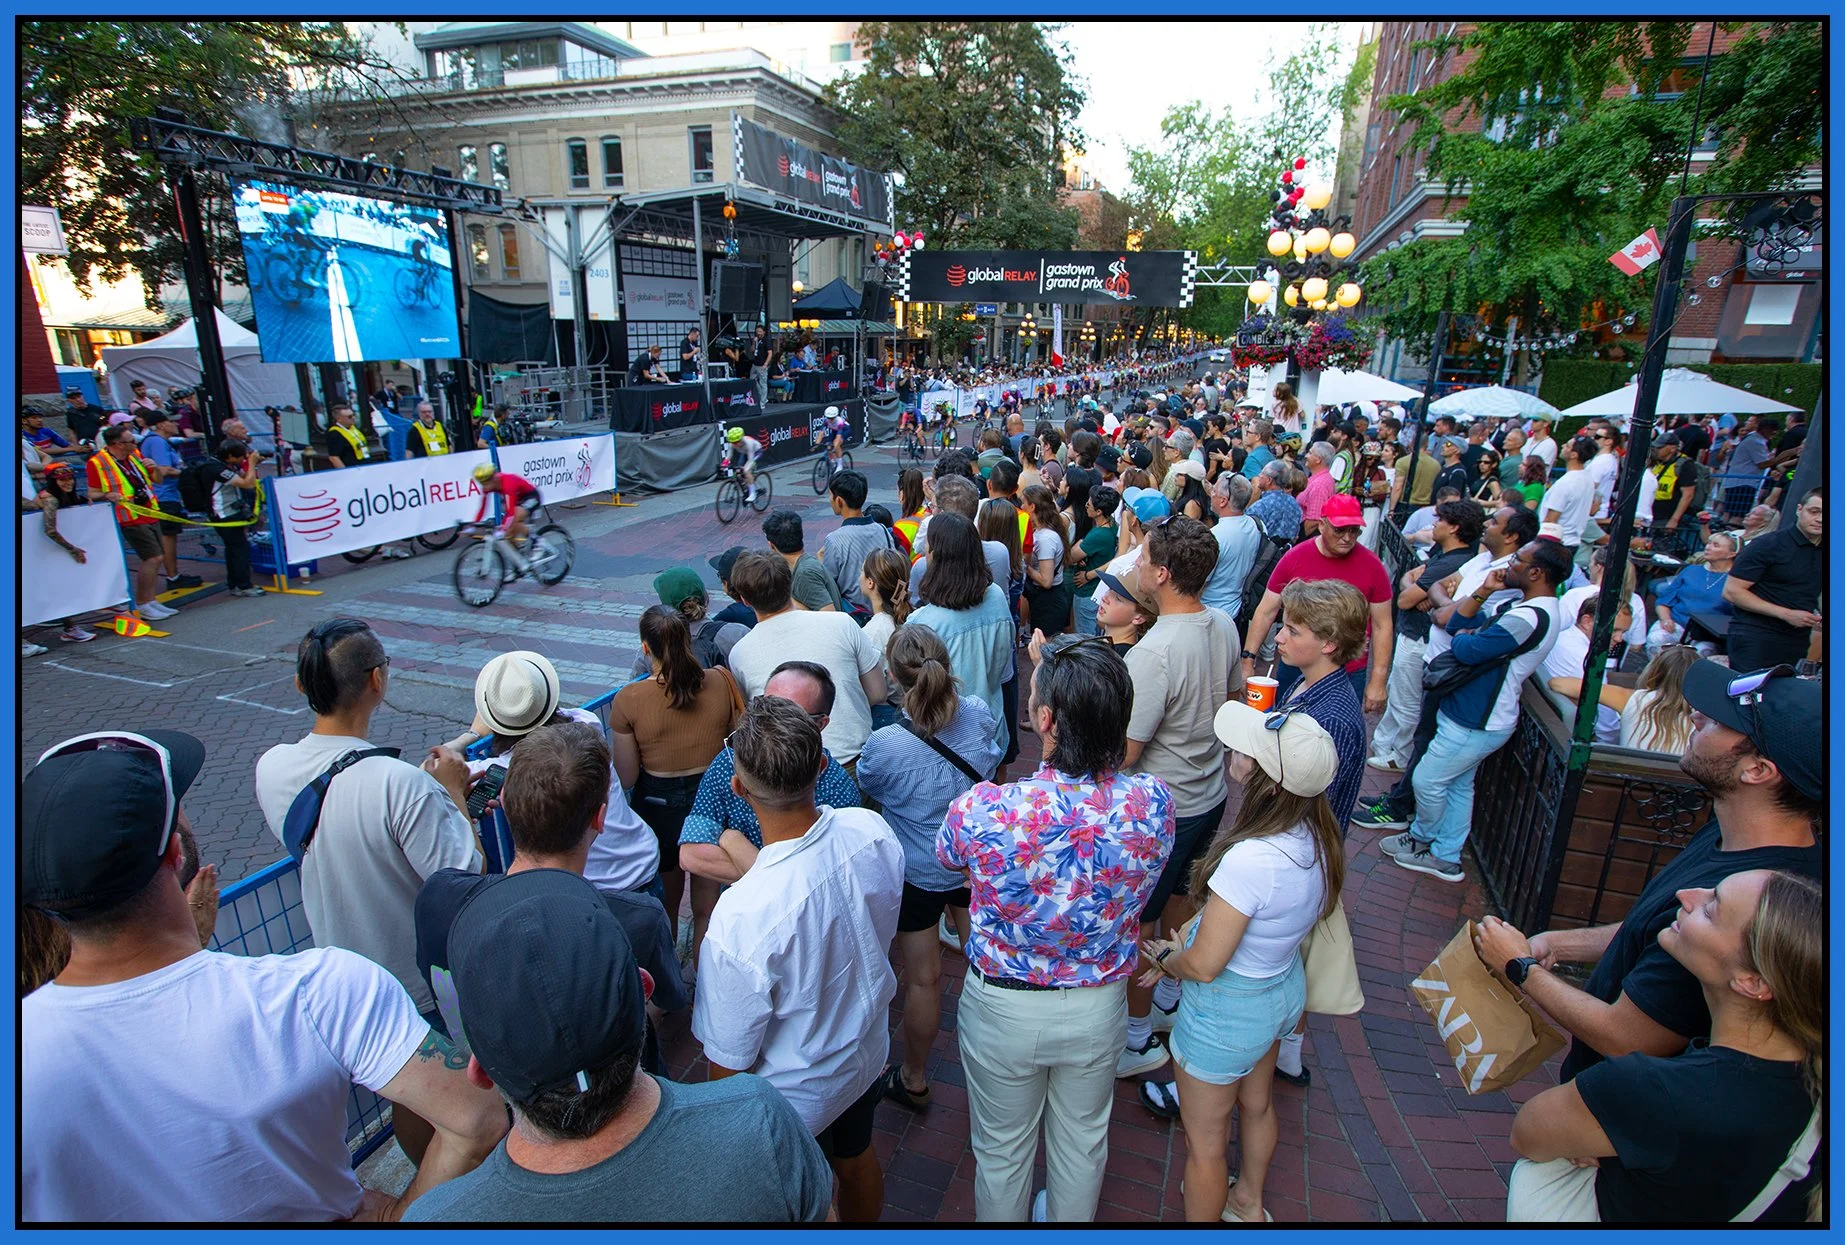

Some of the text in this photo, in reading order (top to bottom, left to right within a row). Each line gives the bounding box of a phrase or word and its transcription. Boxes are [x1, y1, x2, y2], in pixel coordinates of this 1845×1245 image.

[825, 171, 847, 186] gastown
[825, 183, 851, 199] grand prix
[24, 227, 51, 237] SCOOP
[589, 268, 610, 278] 2403
[1045, 263, 1096, 278] gastown
[1045, 275, 1104, 291] grand prix
[662, 401, 699, 417] globalRELAY
[770, 426, 809, 446] globalRELAY
[812, 428, 830, 442] grnd
[523, 456, 566, 476] gastown
[527, 469, 574, 487] rand prix
[347, 478, 482, 527] globalRELA
[1411, 958, 1498, 1094] ZARA
